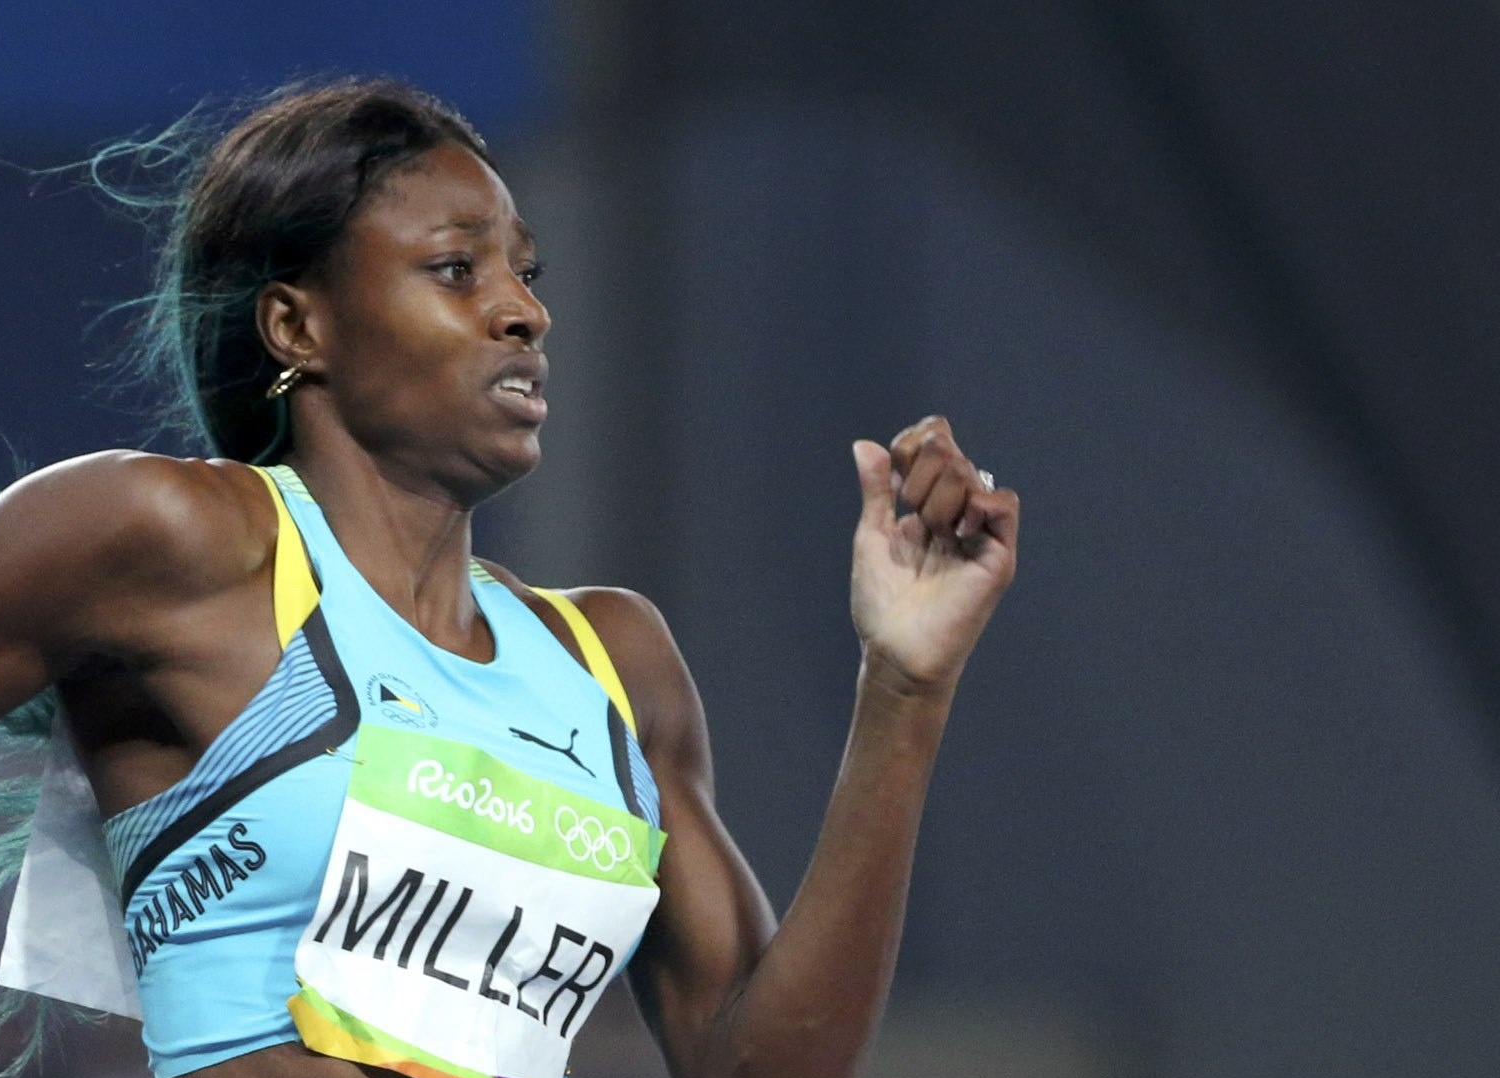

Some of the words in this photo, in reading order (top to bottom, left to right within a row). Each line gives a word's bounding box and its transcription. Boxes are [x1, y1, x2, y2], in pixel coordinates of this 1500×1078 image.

[406, 758, 536, 835] Rio2016
[127, 822, 267, 981] BAHAMAS
[312, 850, 616, 1039] MILLER
